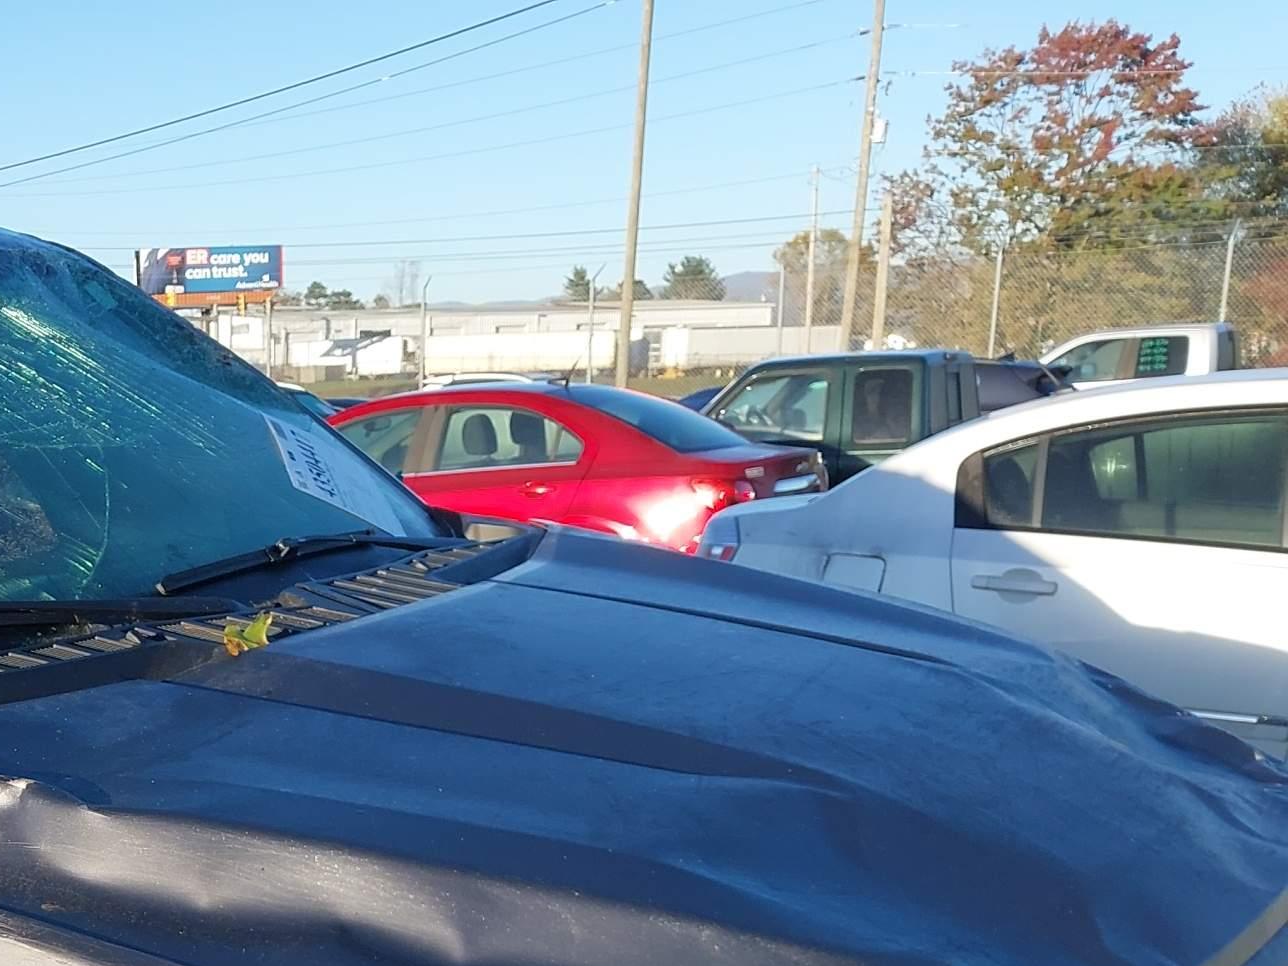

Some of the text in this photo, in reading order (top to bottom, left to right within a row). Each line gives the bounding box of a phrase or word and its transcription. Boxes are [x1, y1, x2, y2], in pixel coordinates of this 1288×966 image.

[186, 249, 209, 265] ER
[210, 253, 240, 264] care
[243, 251, 270, 265] you
[184, 265, 248, 280] can trust.
